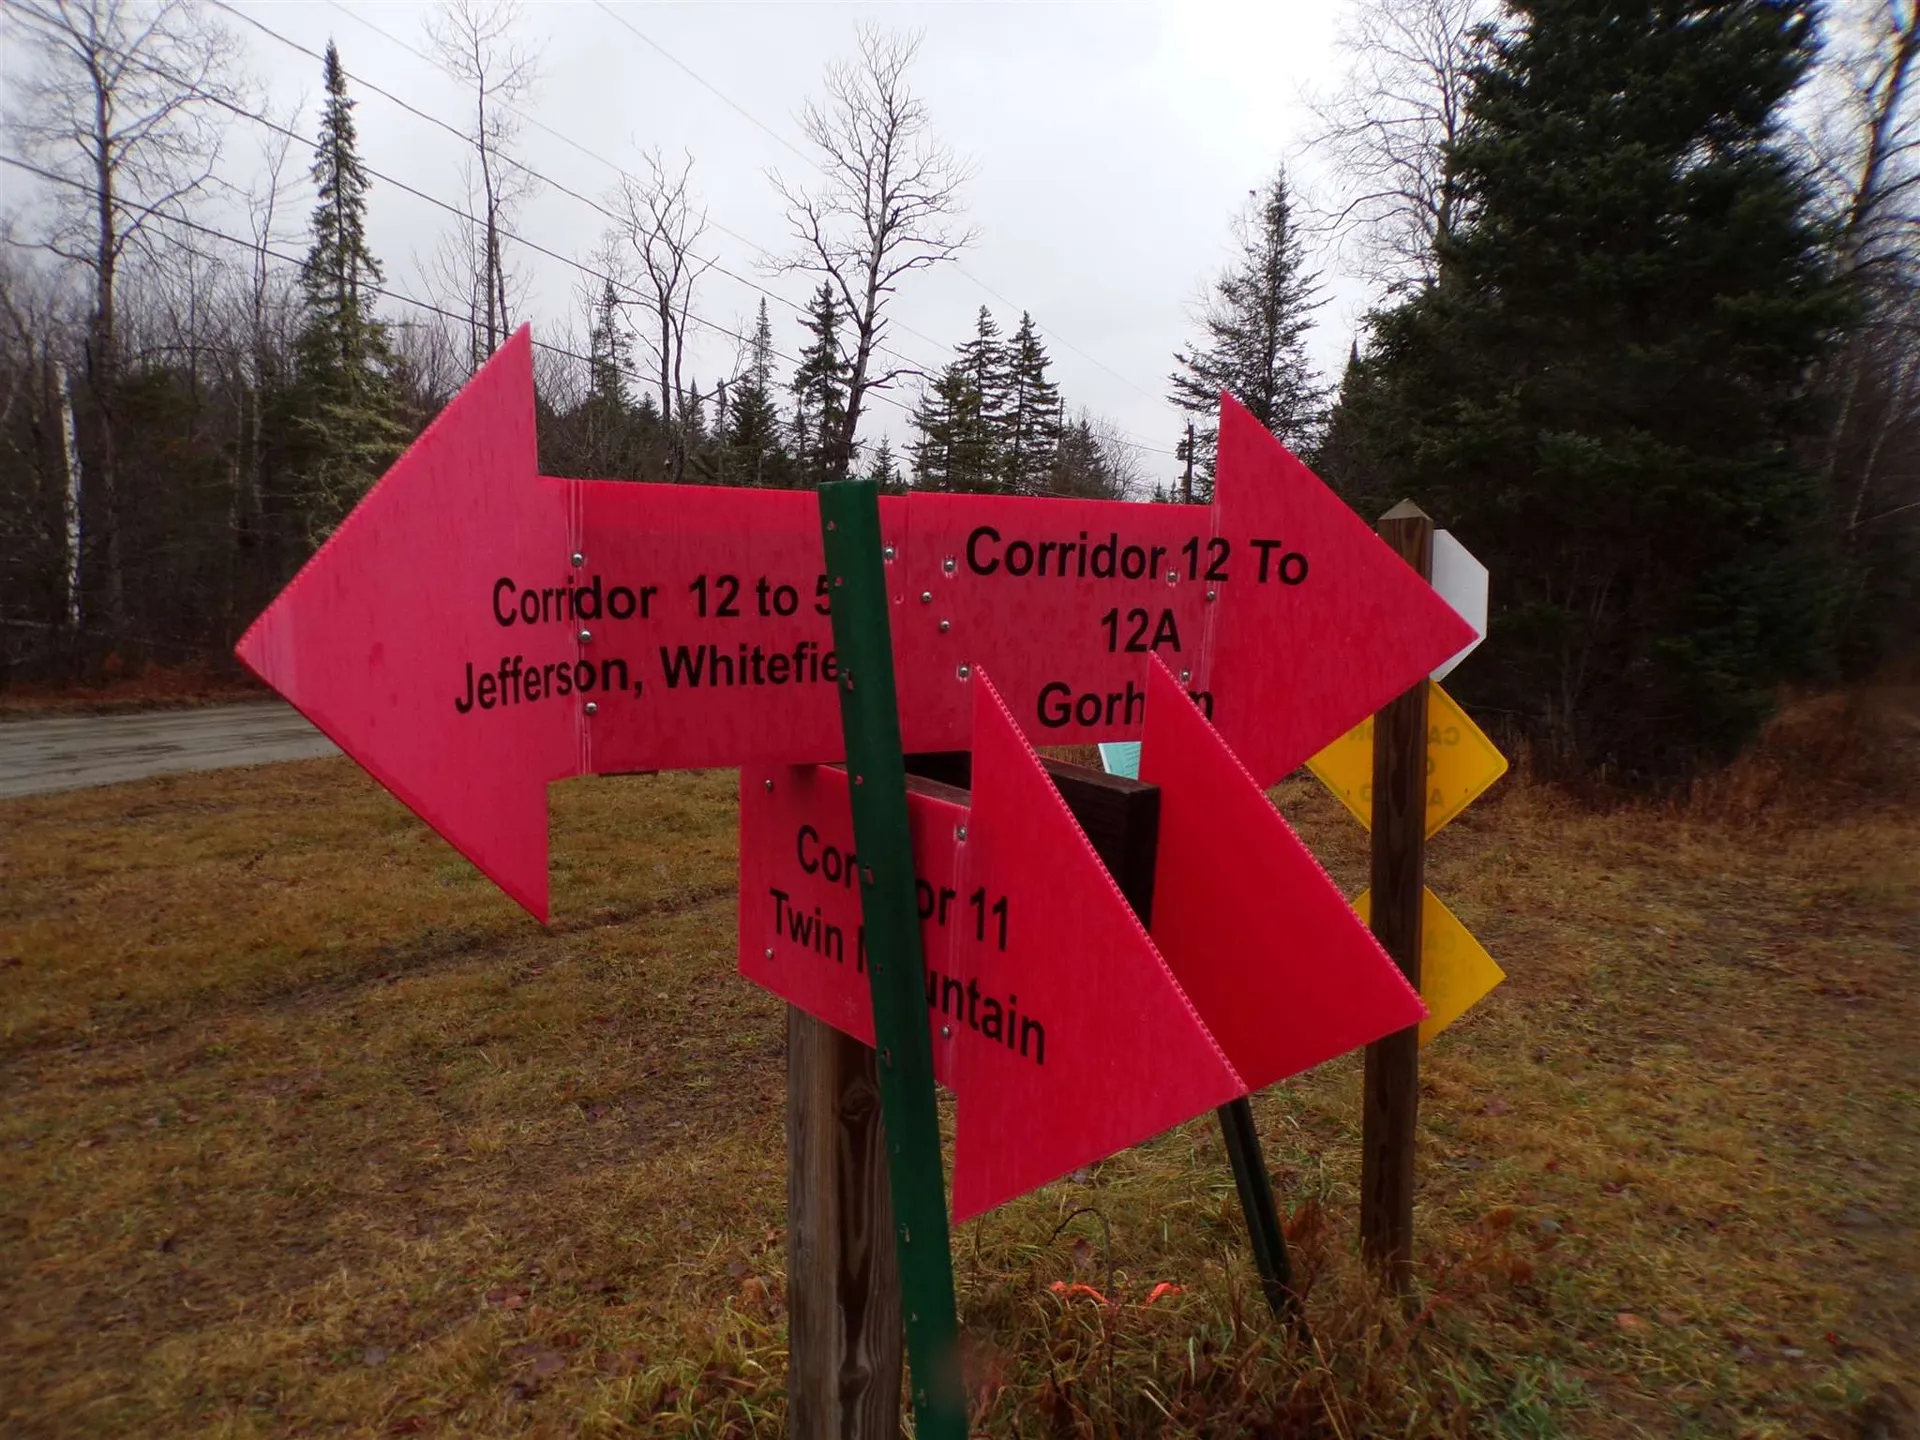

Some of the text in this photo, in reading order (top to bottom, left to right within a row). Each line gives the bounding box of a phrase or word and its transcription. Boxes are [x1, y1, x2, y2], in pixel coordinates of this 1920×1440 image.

[966, 525, 1309, 586] Corridor 12 To
[492, 573, 657, 627] Corridor
[689, 574, 740, 618] 12
[756, 576, 799, 617] to
[1101, 608, 1181, 653] 12A
[455, 641, 838, 714] Jefferson, Whitefie
[797, 825, 1009, 952] Coror 11
[769, 888, 844, 964] Twin
